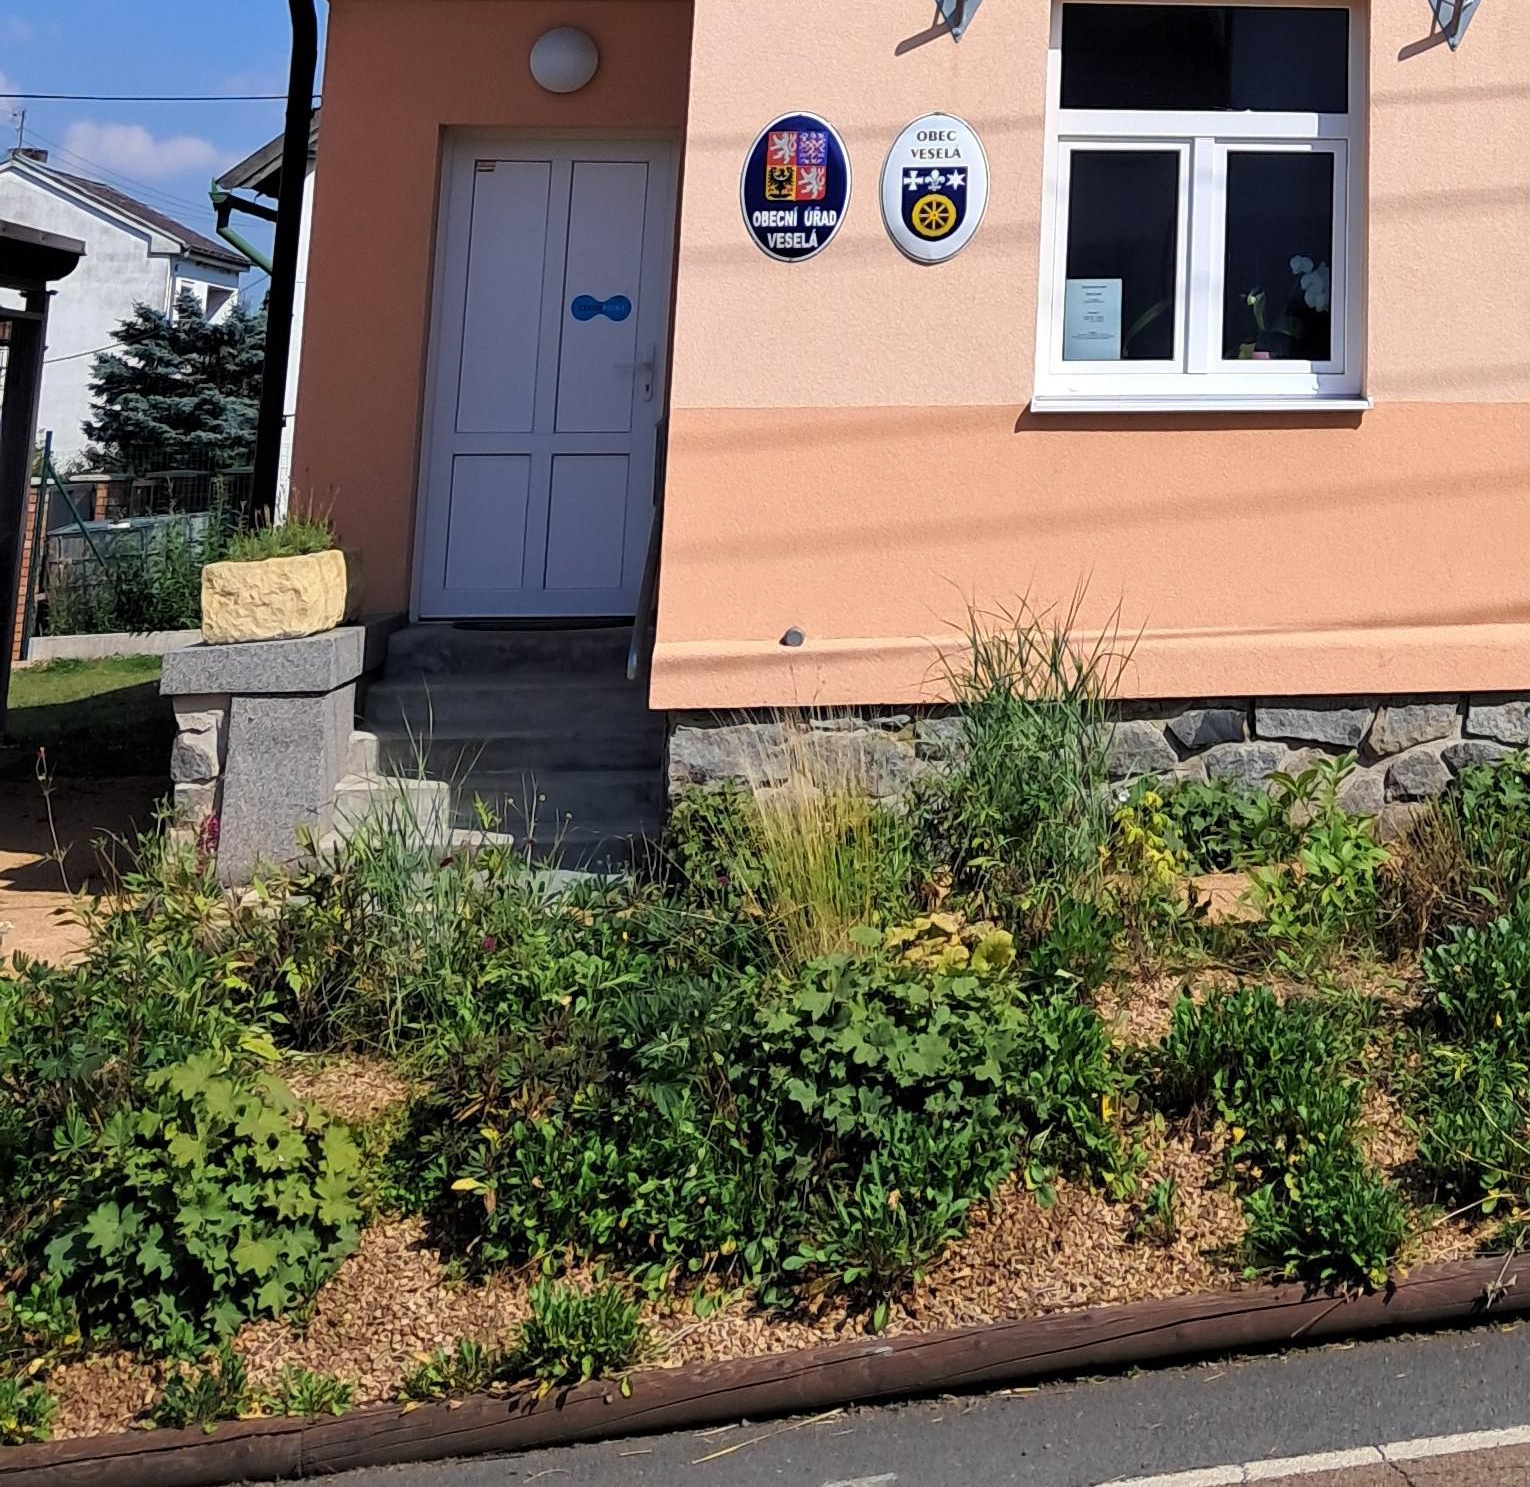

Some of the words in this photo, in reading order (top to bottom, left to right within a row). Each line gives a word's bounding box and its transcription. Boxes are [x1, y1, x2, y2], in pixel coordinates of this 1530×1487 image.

[916, 130, 957, 142] OBEC
[752, 206, 798, 227] OBECNÍ
[804, 206, 837, 227] ÚŘAD
[767, 229, 818, 248] VESELÁ
